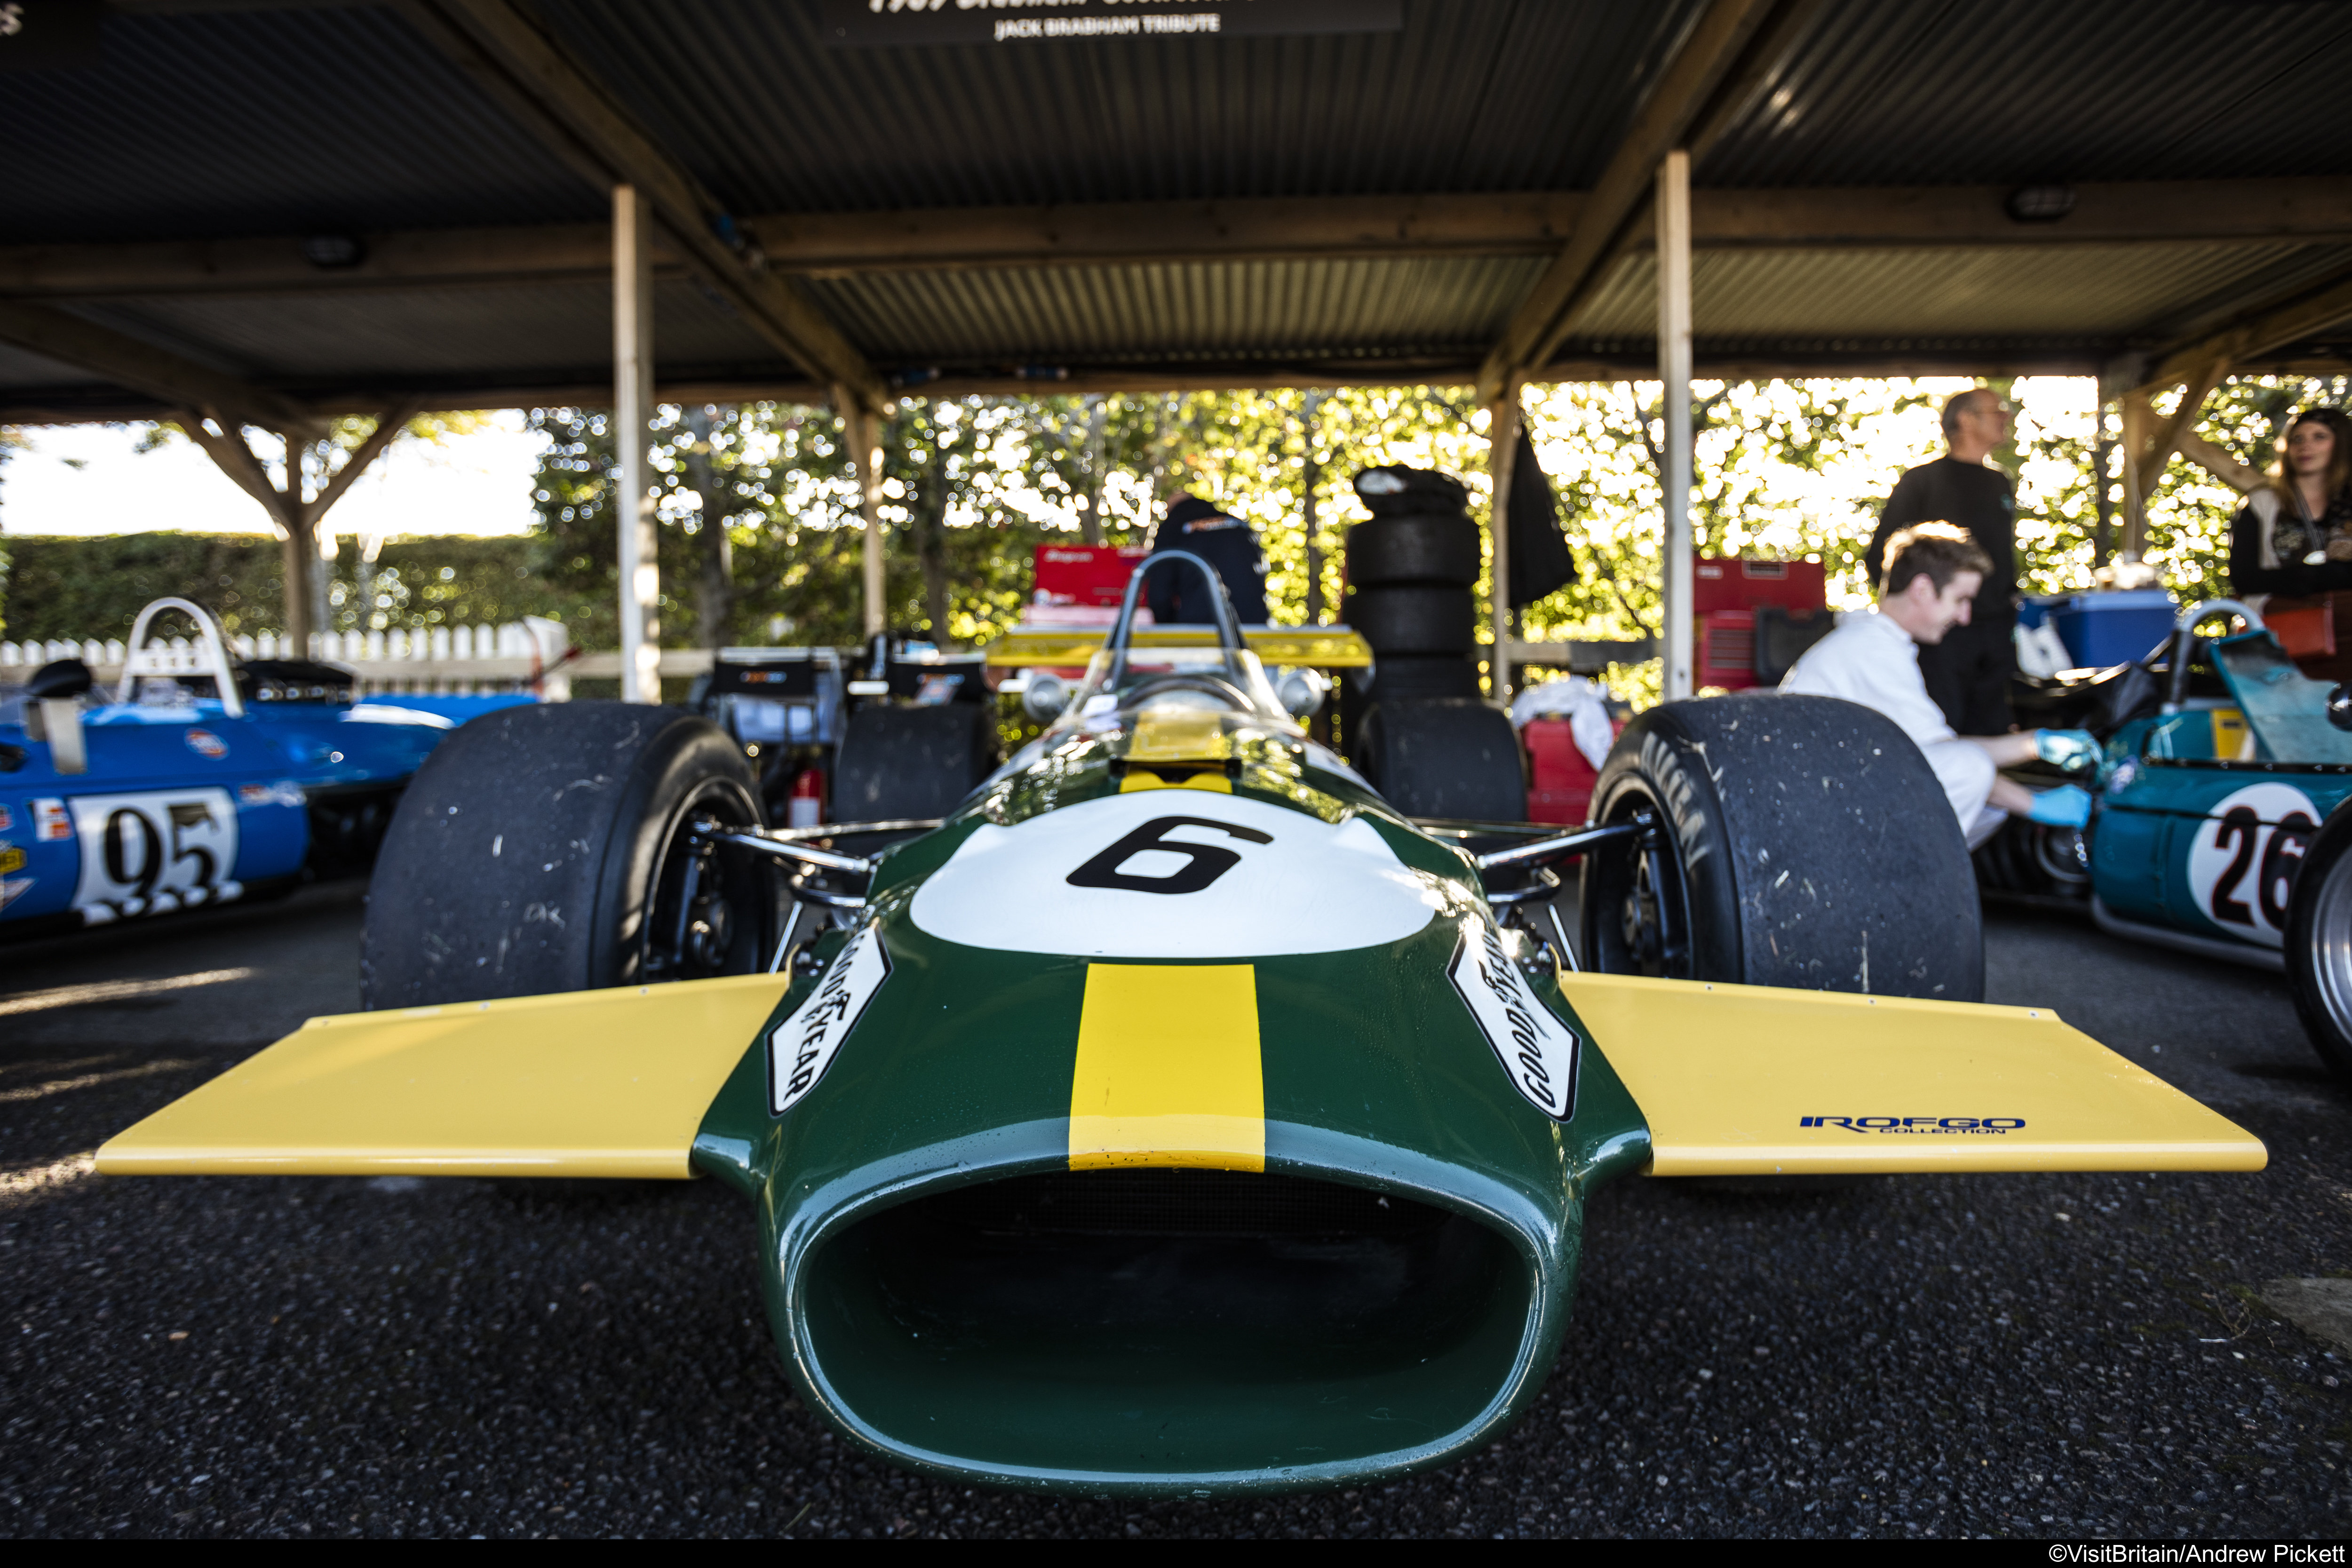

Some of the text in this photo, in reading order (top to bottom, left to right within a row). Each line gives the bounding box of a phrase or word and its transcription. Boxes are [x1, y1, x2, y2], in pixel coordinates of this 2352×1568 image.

[994, 13, 1221, 41] JACK BRABHAM TRIBUTE
[1065, 816, 1274, 894] 6
[2212, 804, 2312, 931] 26
[784, 934, 865, 1102] GOODYEAR
